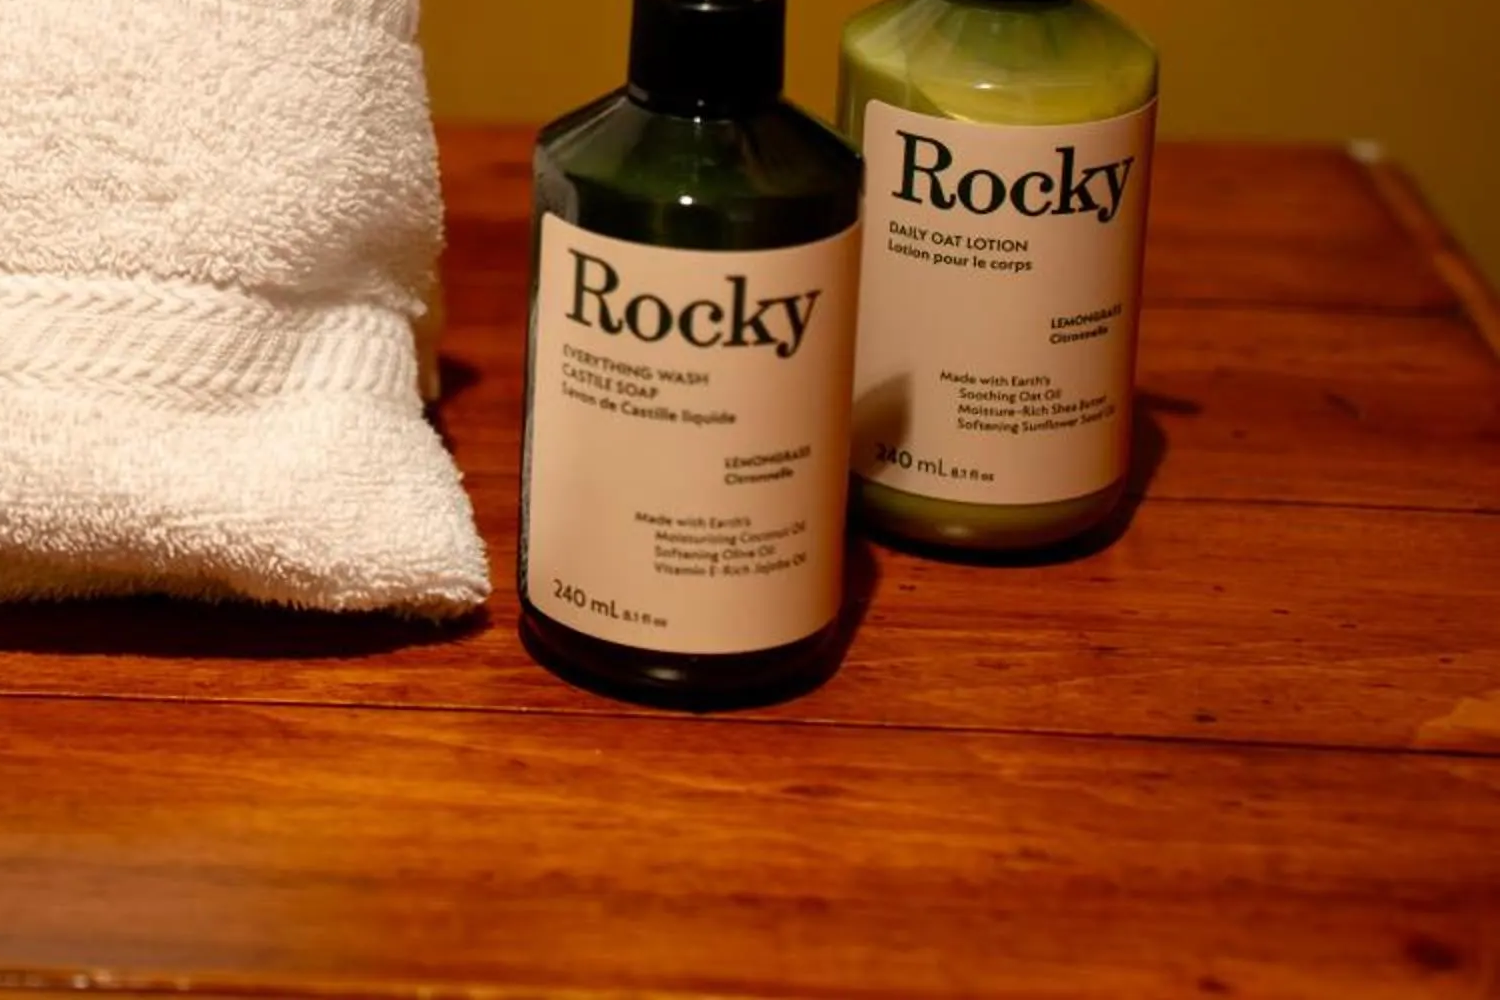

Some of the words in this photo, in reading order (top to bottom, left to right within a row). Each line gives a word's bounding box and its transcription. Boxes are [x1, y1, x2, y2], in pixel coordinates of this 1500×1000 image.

[892, 130, 1134, 223] Rocky
[889, 221, 928, 242] DAILY
[931, 231, 963, 248] OAT
[966, 238, 1029, 252] LOTION
[888, 238, 930, 261] Lotion
[933, 252, 968, 267] pour
[973, 255, 987, 269] le
[990, 260, 1033, 273] corps
[565, 248, 823, 359] Rocky
[562, 363, 611, 391] CASTILE
[616, 380, 658, 400] SOAP
[563, 344, 653, 380] EVERYTHING
[658, 369, 709, 385] WASH
[940, 371, 977, 385] Made
[980, 376, 1008, 387] with
[561, 381, 597, 406] Savon
[599, 398, 617, 413] de
[621, 401, 677, 422] Castille
[682, 408, 736, 427] liquide
[959, 387, 1016, 404] Soothing
[1019, 390, 1041, 401] Oat
[1045, 388, 1062, 400] Oil
[1051, 402, 1077, 414] Shea
[957, 418, 1018, 434] Softening
[1022, 417, 1078, 432] Sunflower
[876, 443, 912, 469] 240
[918, 457, 947, 477] mL
[553, 578, 586, 608] 240
[591, 599, 619, 618] mL
